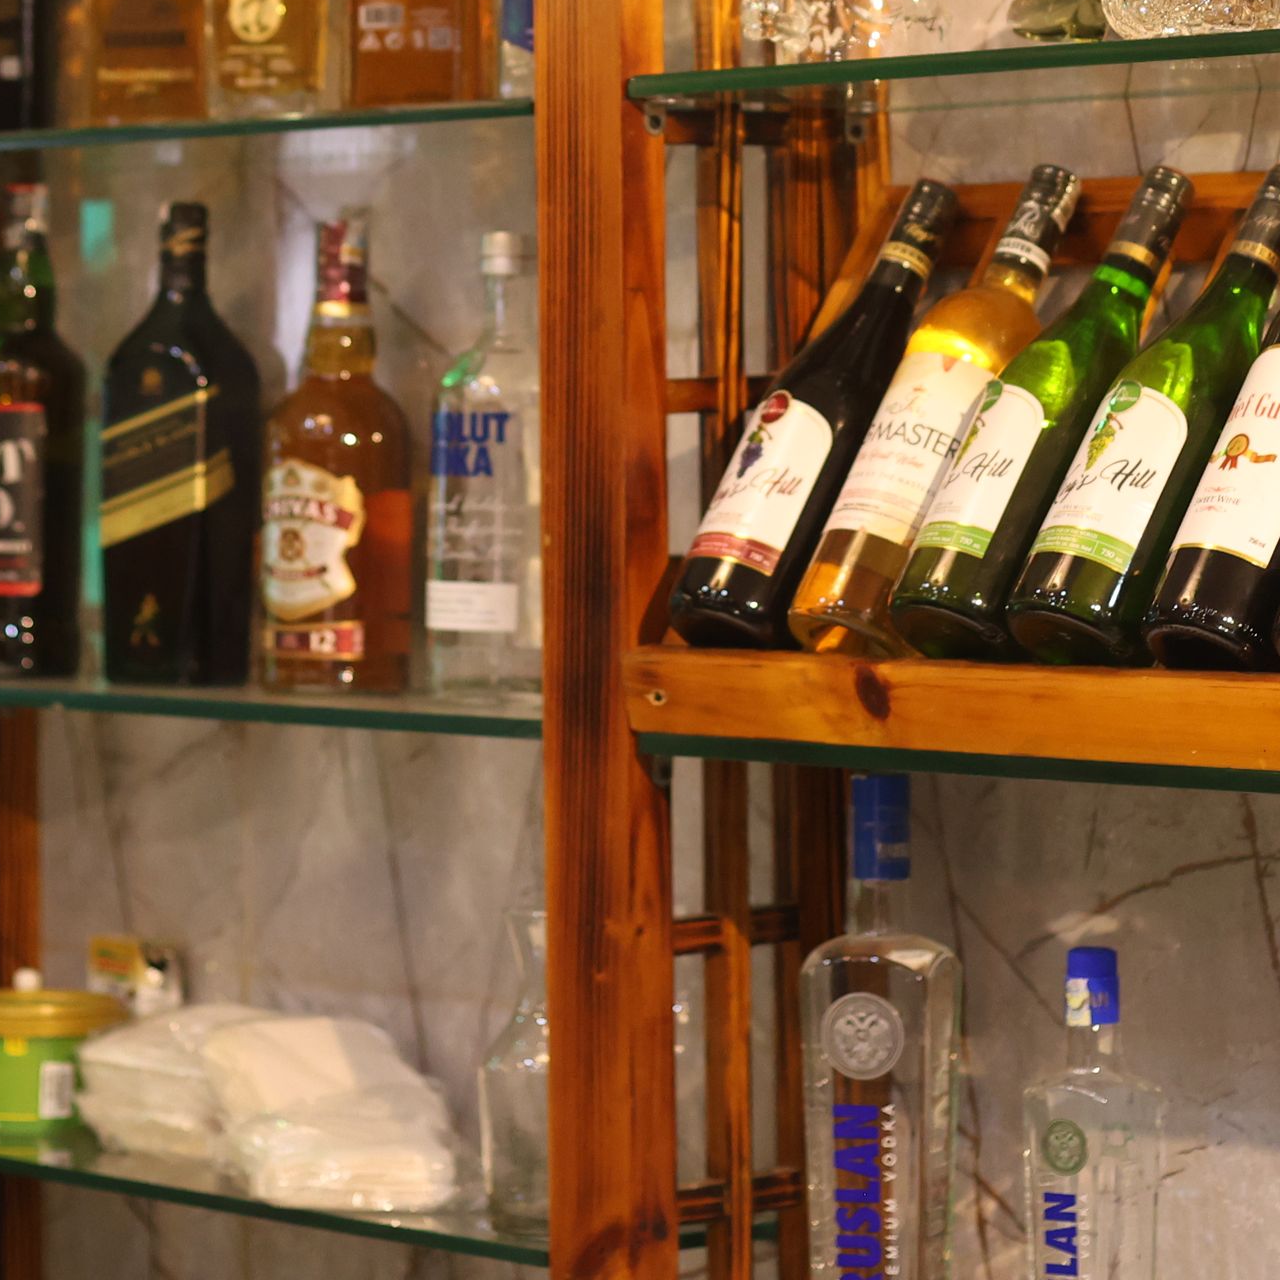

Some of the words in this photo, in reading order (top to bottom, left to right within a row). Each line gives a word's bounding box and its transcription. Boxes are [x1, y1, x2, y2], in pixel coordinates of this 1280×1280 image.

[750, 467, 803, 499] Hill
[962, 450, 1014, 482] Hill
[1099, 458, 1157, 492] Hill
[881, 1103, 897, 1182] VODKA
[833, 1104, 883, 1280] USLAN
[882, 1197, 901, 1276] EMIUM
[1043, 1191, 1079, 1280] LAN
